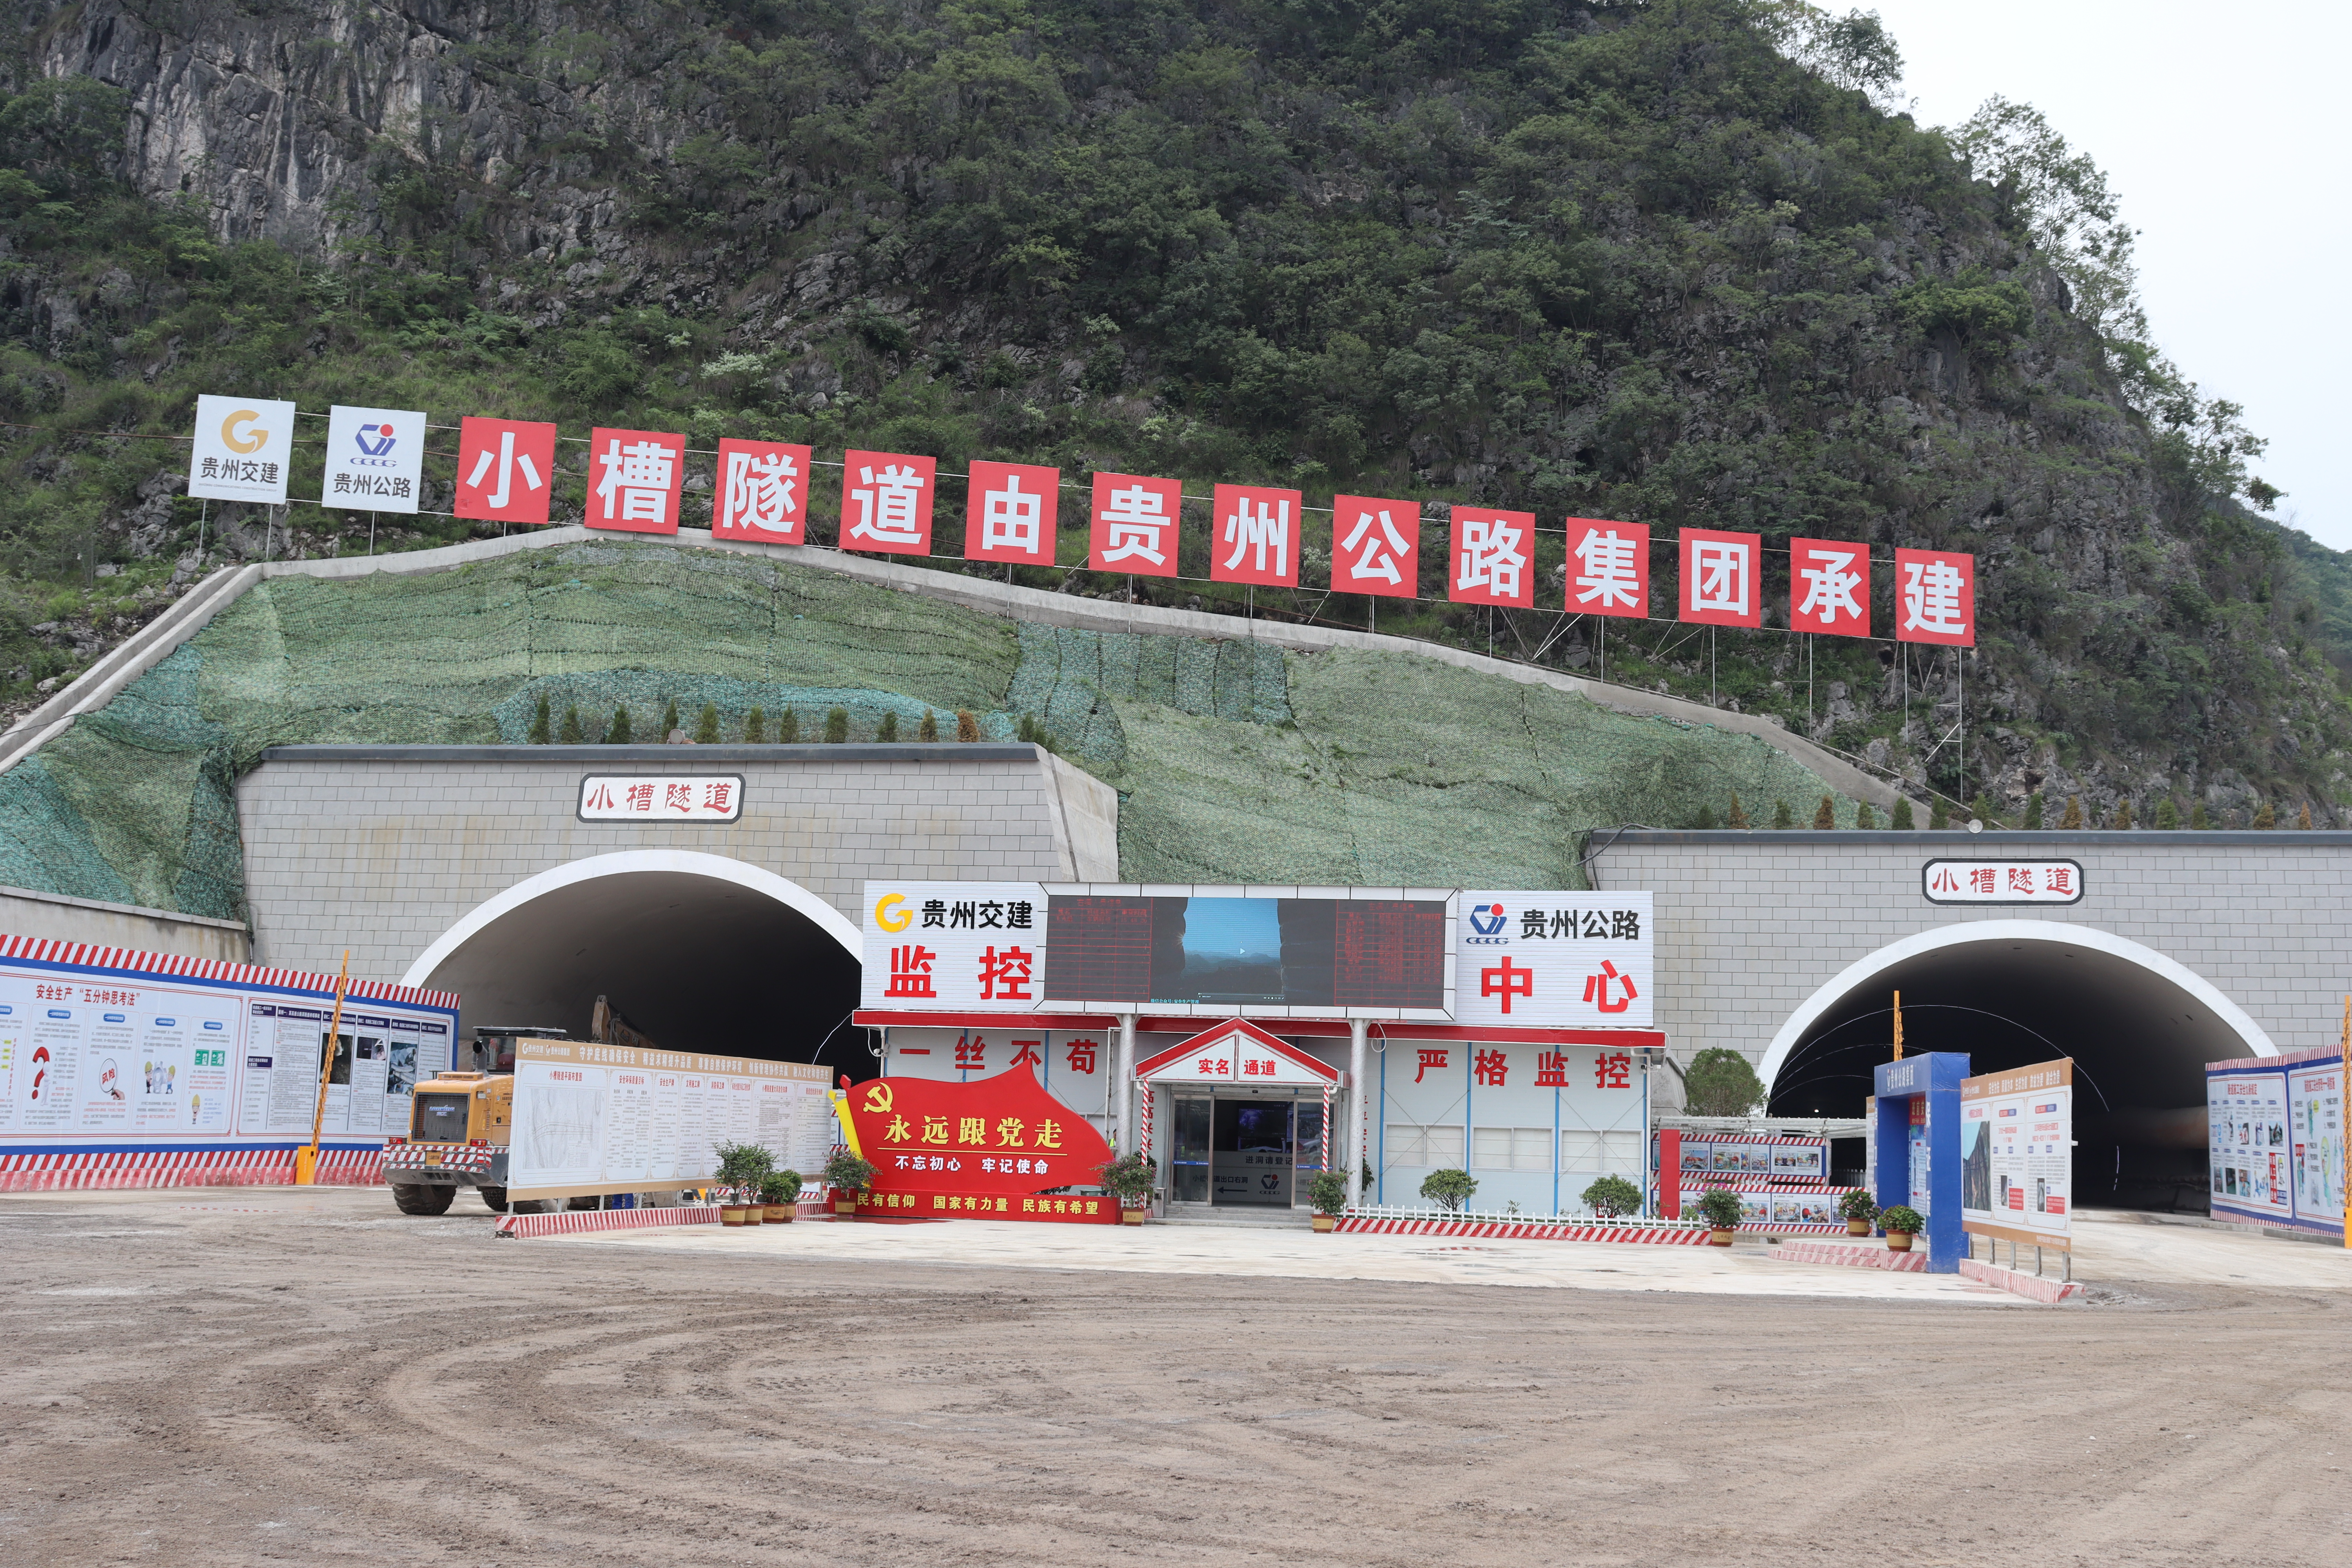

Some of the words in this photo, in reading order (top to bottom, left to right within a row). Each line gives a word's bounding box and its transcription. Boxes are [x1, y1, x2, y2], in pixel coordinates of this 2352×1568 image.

[201, 457, 278, 484] 贵州交建
[334, 473, 411, 498] 贵州公路
[466, 432, 1966, 635] 小槽隧道由贵州公路集团承建
[587, 784, 732, 813] 小槽隧道
[1932, 868, 2073, 895] 小槽隧道
[922, 899, 1032, 929] 贵州交建
[1521, 909, 1640, 940] 贵州公路
[884, 945, 1032, 1000] 监控
[1481, 956, 1638, 1014] 中心
[36, 984, 73, 1001] 安全生产
[80, 987, 140, 1006] “五分钟思考法”
[528, 1045, 544, 1053] 贵州交建
[551, 1047, 570, 1056] 贵州公路集团
[579, 1046, 635, 1064] 守护底线确保安全
[642, 1051, 691, 1069] 精益求精提升品质
[698, 1057, 742, 1073] 尊重自然保护环境
[749, 1062, 788, 1077] 创新管理协作共赢
[793, 1066, 829, 1080] 融入文化和谐共生
[900, 1036, 1098, 1074] 一丝不苟
[102, 1068, 115, 1085] 风险
[549, 1071, 583, 1082] 小槽隧道平面布置图
[1198, 1058, 1276, 1076] 实名通道
[1415, 1049, 1631, 1089] 严格监控
[1891, 1064, 1914, 1089] 贵州公路集团
[619, 1075, 644, 1085] 安全环保质量目标
[659, 1078, 674, 1087] 安全生产牌
[686, 1080, 700, 1088] 文明施工牌
[884, 1114, 1063, 1149] 永远跟党走
[895, 1154, 961, 1172] 不忘初心
[982, 1158, 1049, 1175] 牢记使命
[1245, 1156, 1292, 1165] 进洞请登记
[1193, 1175, 1248, 1184] 小槽道出口右洞
[847, 1192, 916, 1208] 民有信仰
[933, 1195, 1008, 1211] 国家有力量
[1022, 1199, 1098, 1215] 民族有希望
